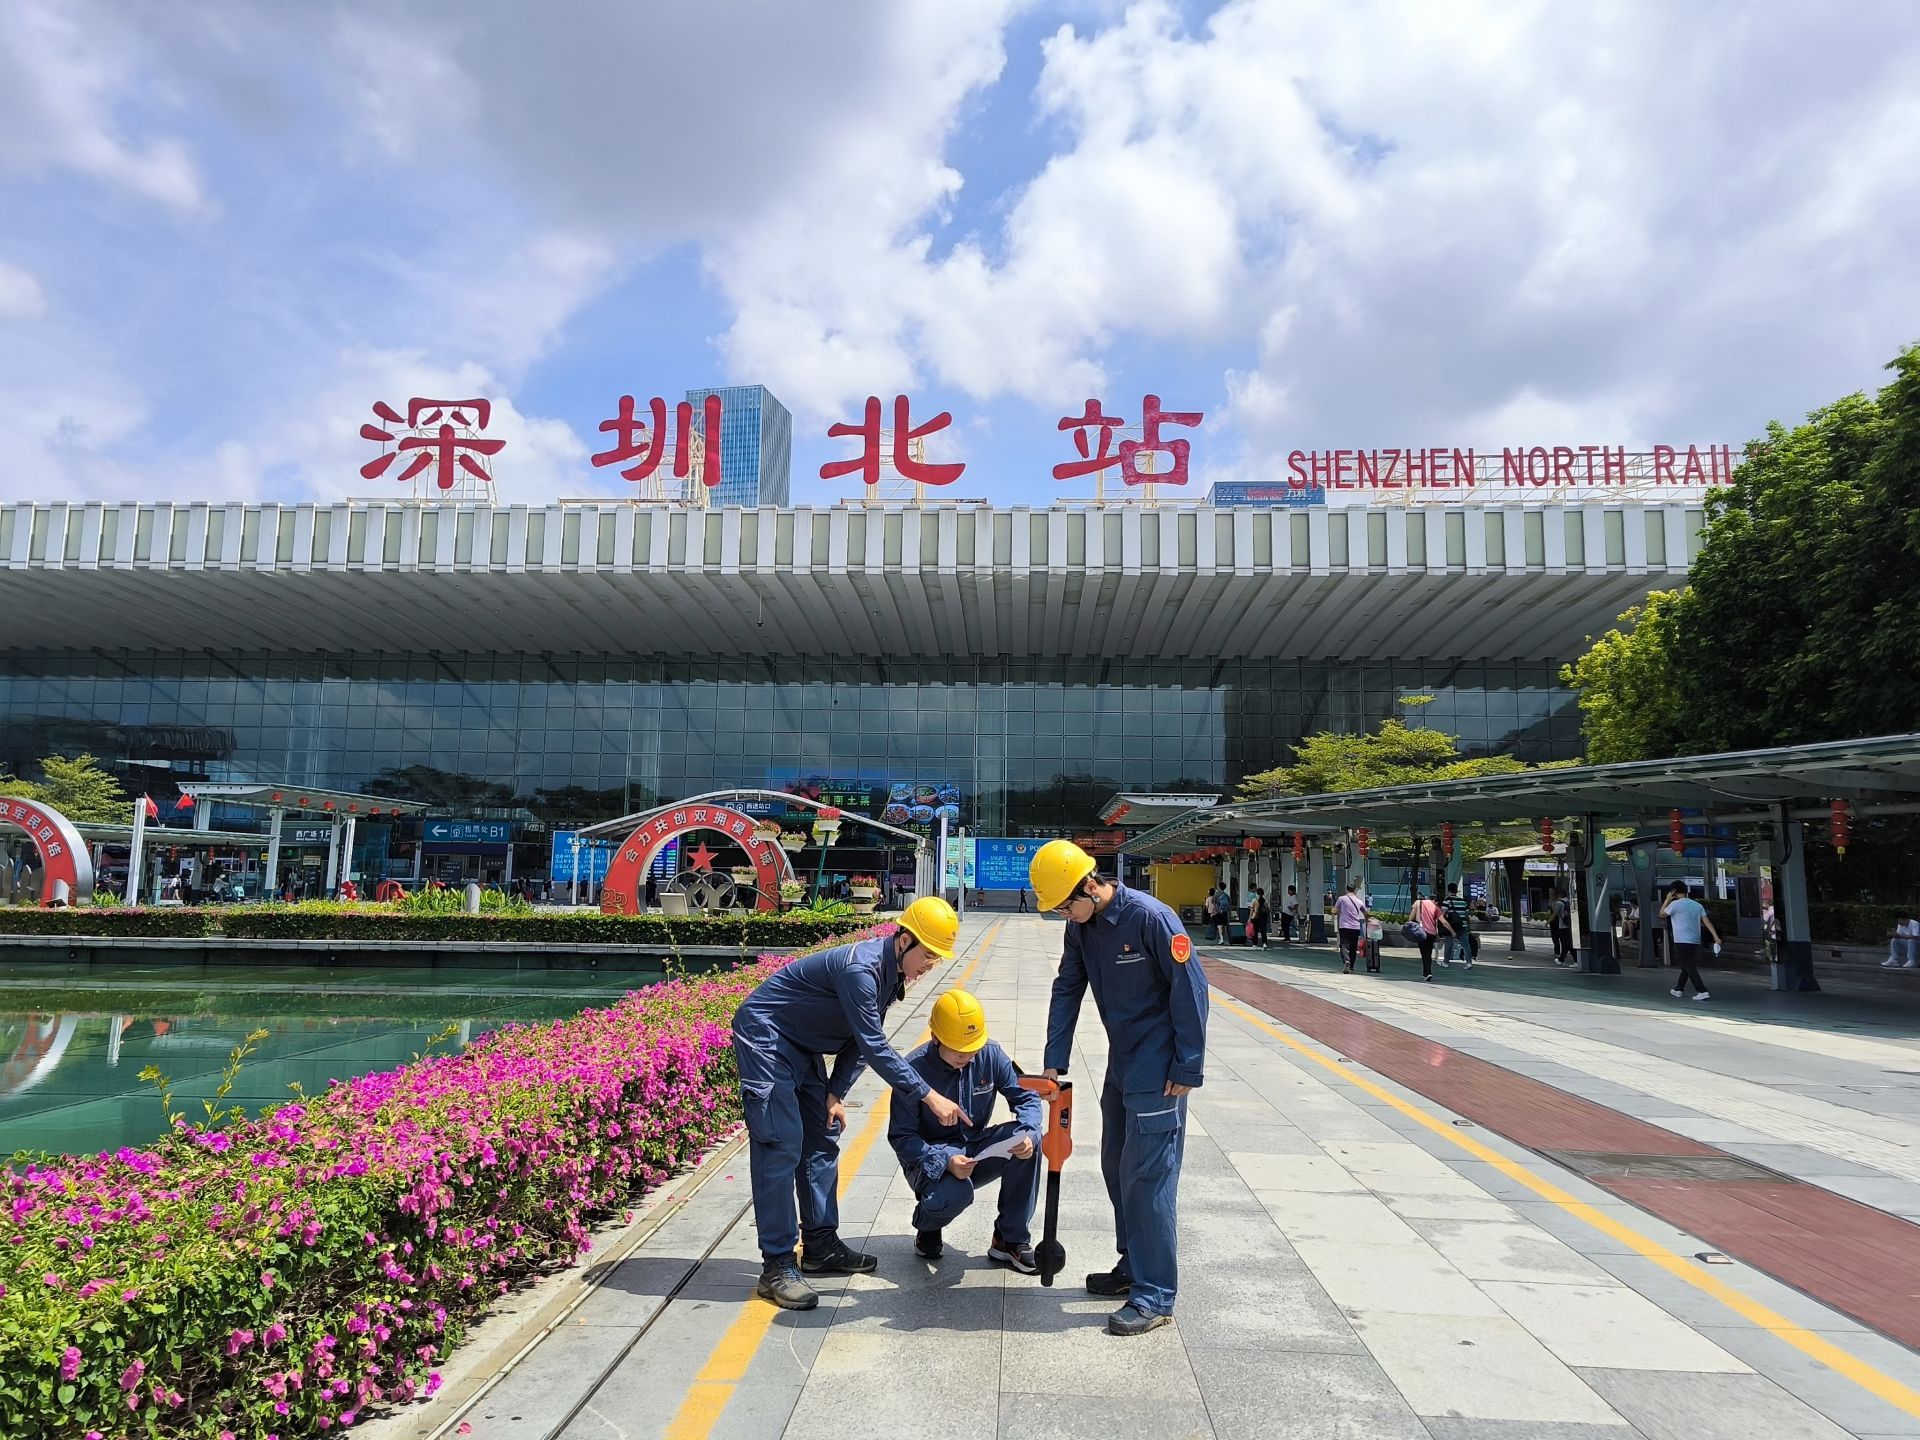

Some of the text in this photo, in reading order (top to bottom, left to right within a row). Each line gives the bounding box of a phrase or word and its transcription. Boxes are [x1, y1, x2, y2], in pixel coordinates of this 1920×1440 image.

[360, 394, 1203, 489] 深圳北站
[1287, 444, 1735, 490] SHENZHEN NORTH RAIL
[490, 826, 504, 837] B1
[625, 809, 774, 866] 合力共创双拥模范城
